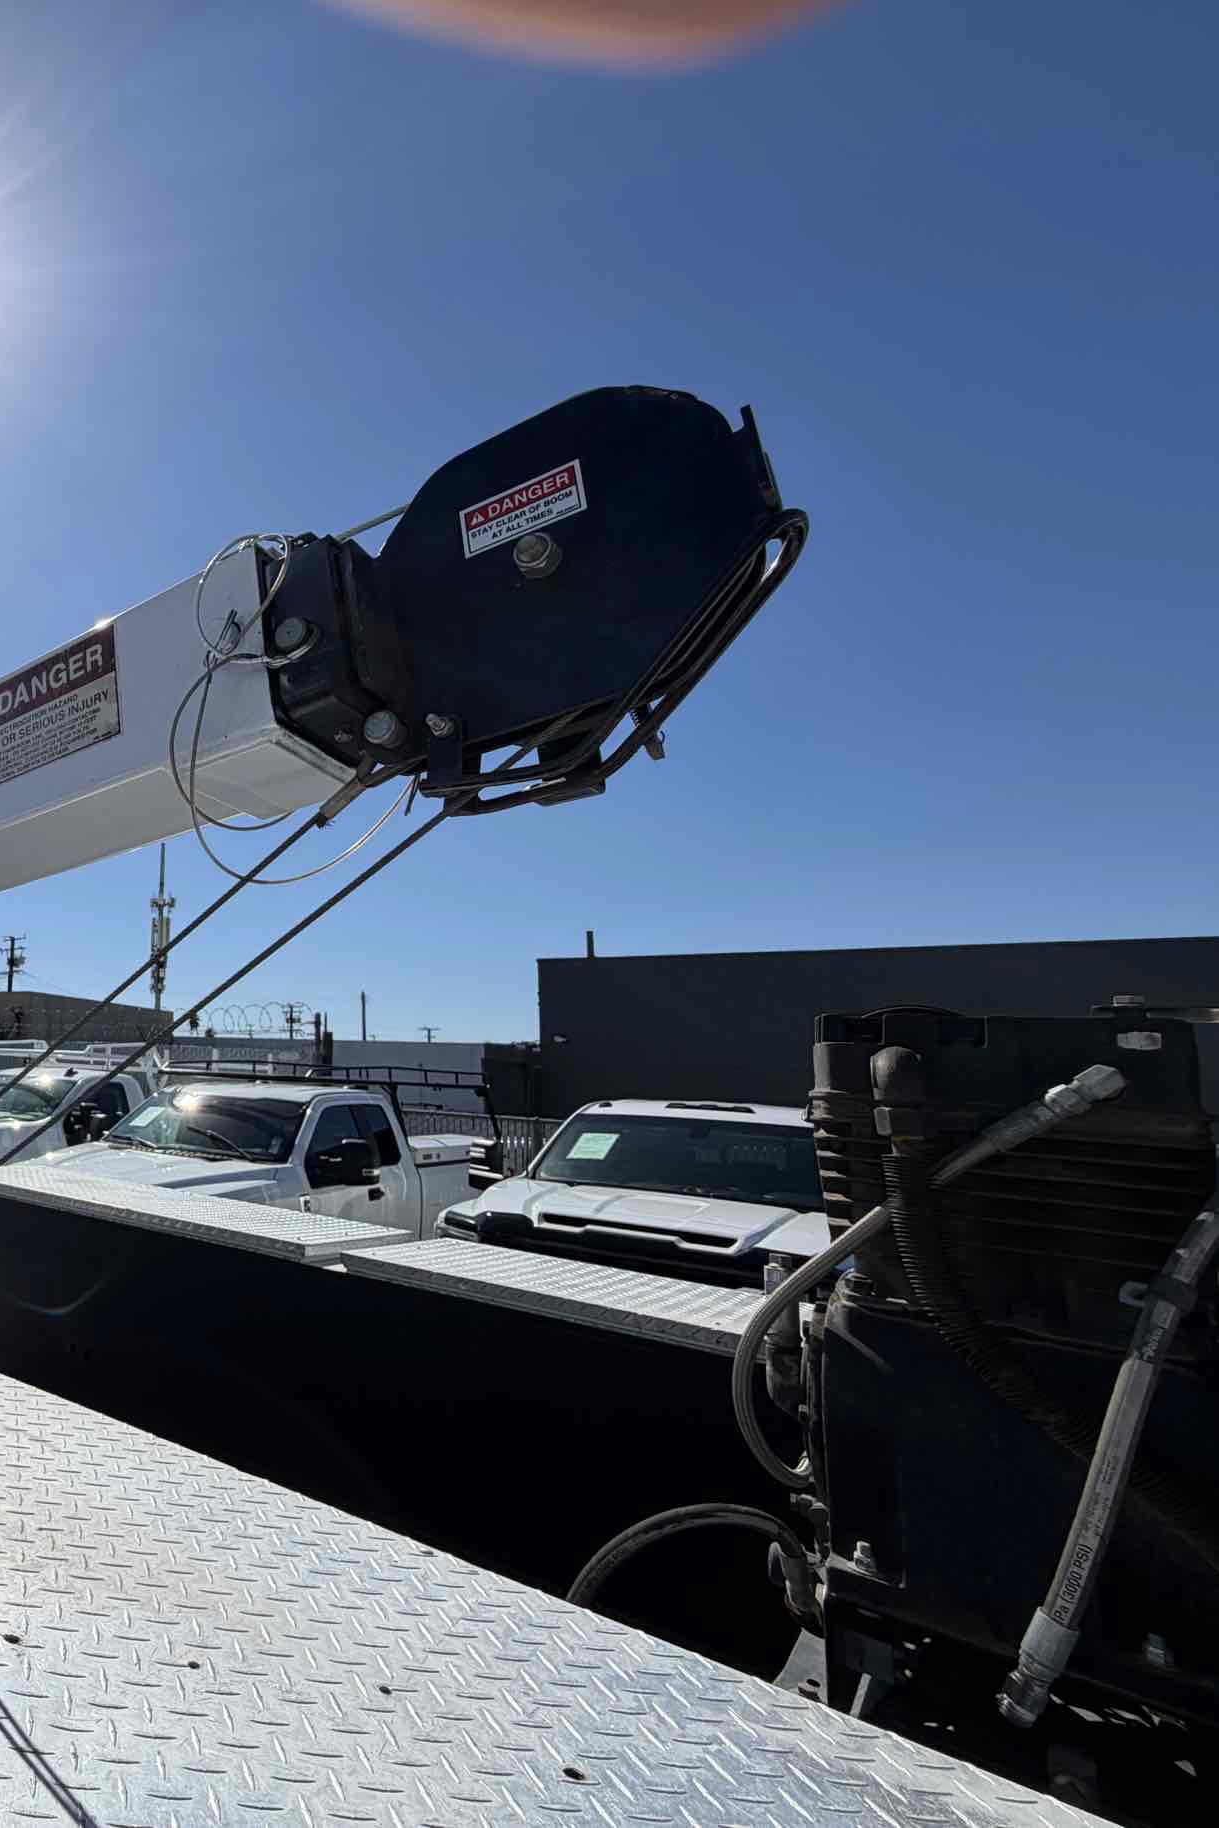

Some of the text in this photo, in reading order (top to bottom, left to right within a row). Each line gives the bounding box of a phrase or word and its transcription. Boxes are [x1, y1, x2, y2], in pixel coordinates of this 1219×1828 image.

[471, 524, 494, 539] STAY
[496, 511, 527, 529] CLEAR
[528, 504, 542, 515] OF
[543, 490, 574, 508] BOOM
[487, 472, 570, 518] DANGER
[491, 530, 503, 540] AT
[505, 522, 525, 536] ALL
[525, 509, 554, 526] TIMES
[1, 732, 16, 747] OR
[18, 711, 67, 741] SERIOUS
[67, 689, 110, 717] INJURY
[1061, 1569, 1083, 1605] (3000
[1073, 1543, 1094, 1569] PSI)
